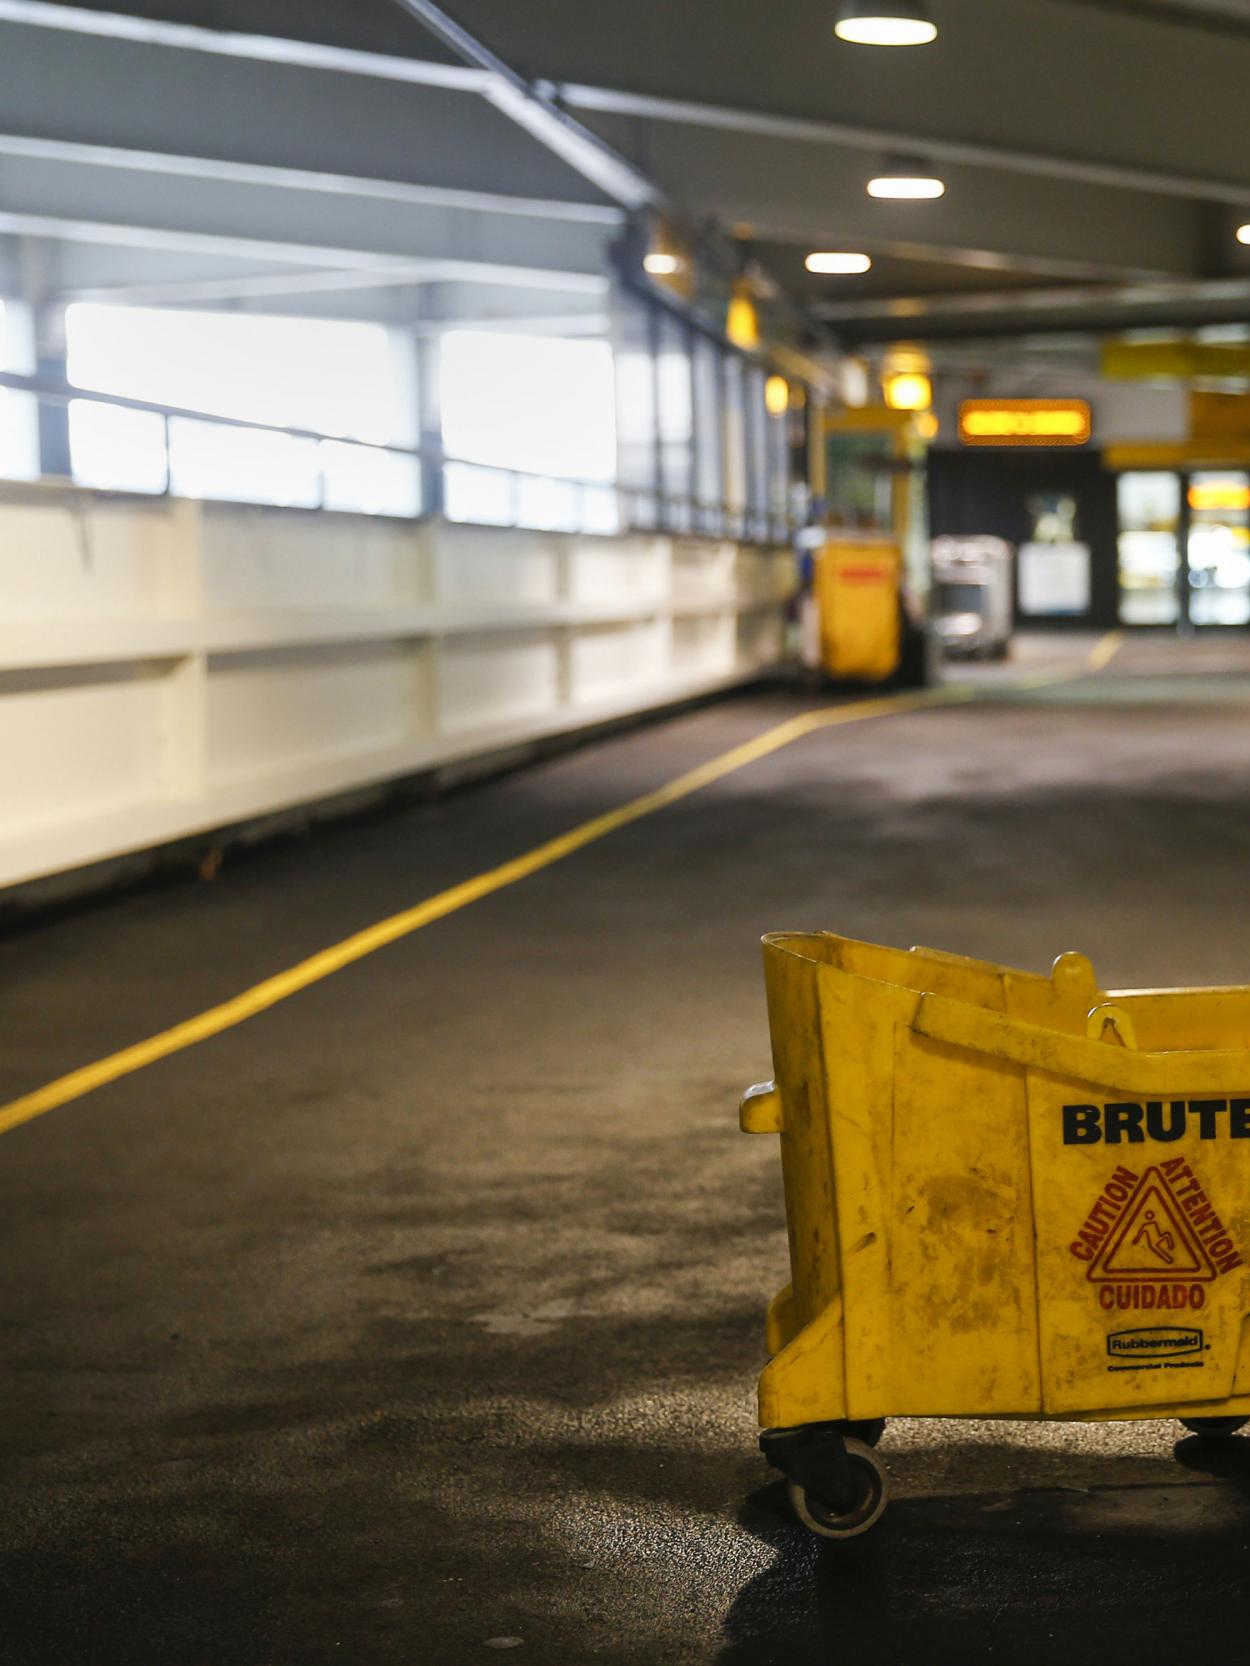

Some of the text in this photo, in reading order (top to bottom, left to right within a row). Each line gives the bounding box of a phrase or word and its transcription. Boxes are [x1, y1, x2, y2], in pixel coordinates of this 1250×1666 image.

[1070, 1166, 1139, 1261] CAUTION
[1160, 1157, 1243, 1274] ATTENTION
[1100, 1284, 1205, 1310] CUIDADO
[1112, 1336, 1198, 1349] Rubbermaid
